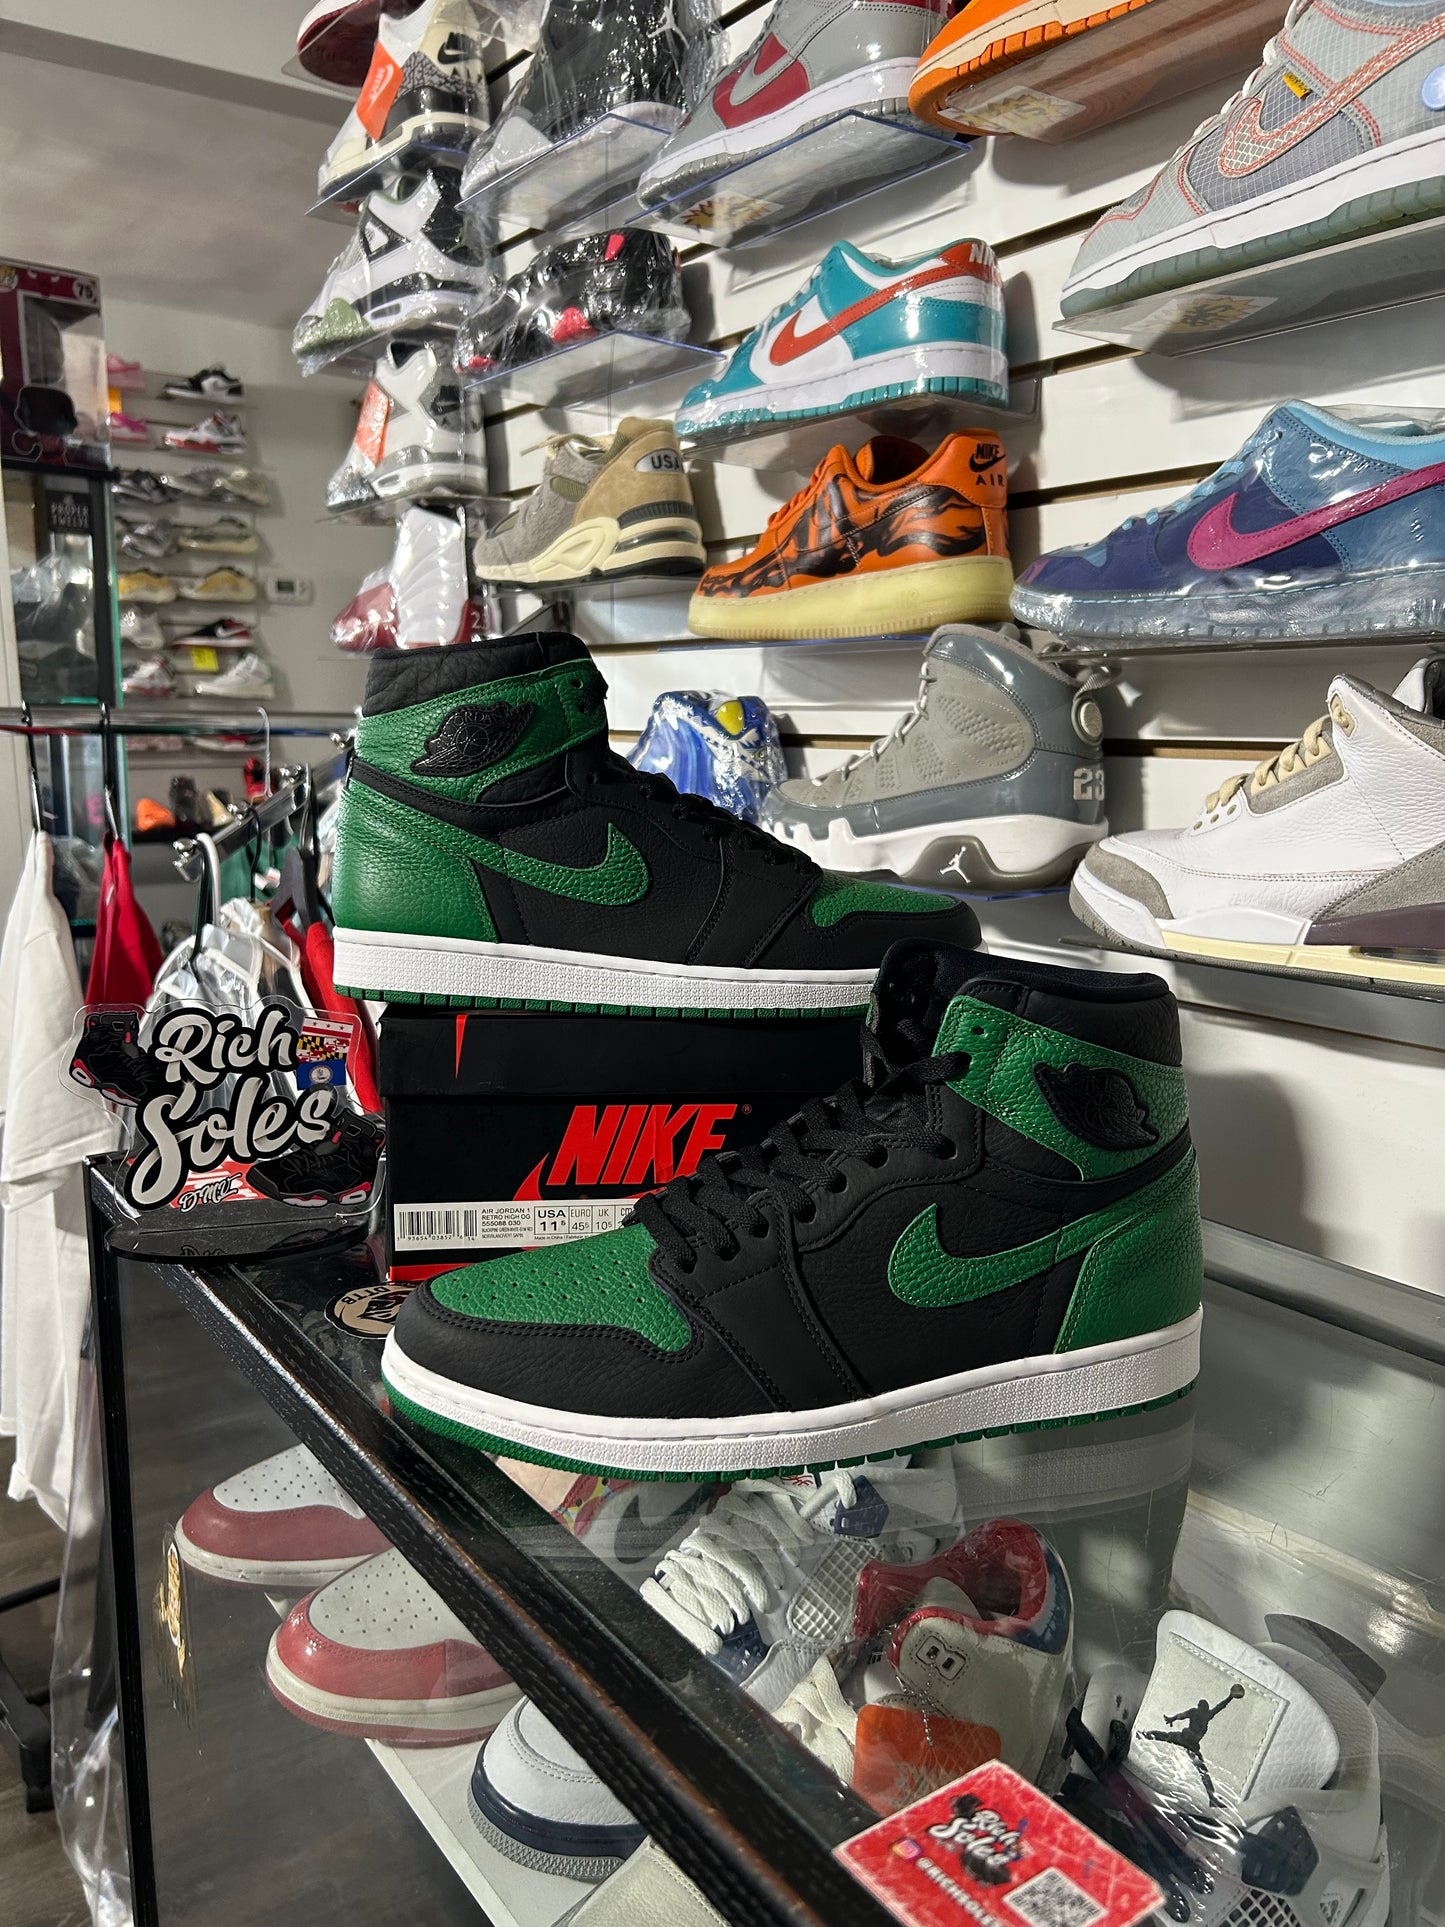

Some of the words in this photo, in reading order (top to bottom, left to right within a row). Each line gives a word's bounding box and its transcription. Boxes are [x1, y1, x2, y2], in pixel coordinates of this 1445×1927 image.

[974, 443, 1000, 459] NIKE
[975, 473, 1004, 487] AIR
[1073, 767, 1105, 801] 23
[154, 1009, 293, 1084] Rich
[130, 1076, 333, 1205] Soles
[546, 1103, 738, 1186] NIKE
[537, 1209, 567, 1219] USA
[570, 1208, 591, 1218] EURO
[598, 1208, 609, 1217] UK
